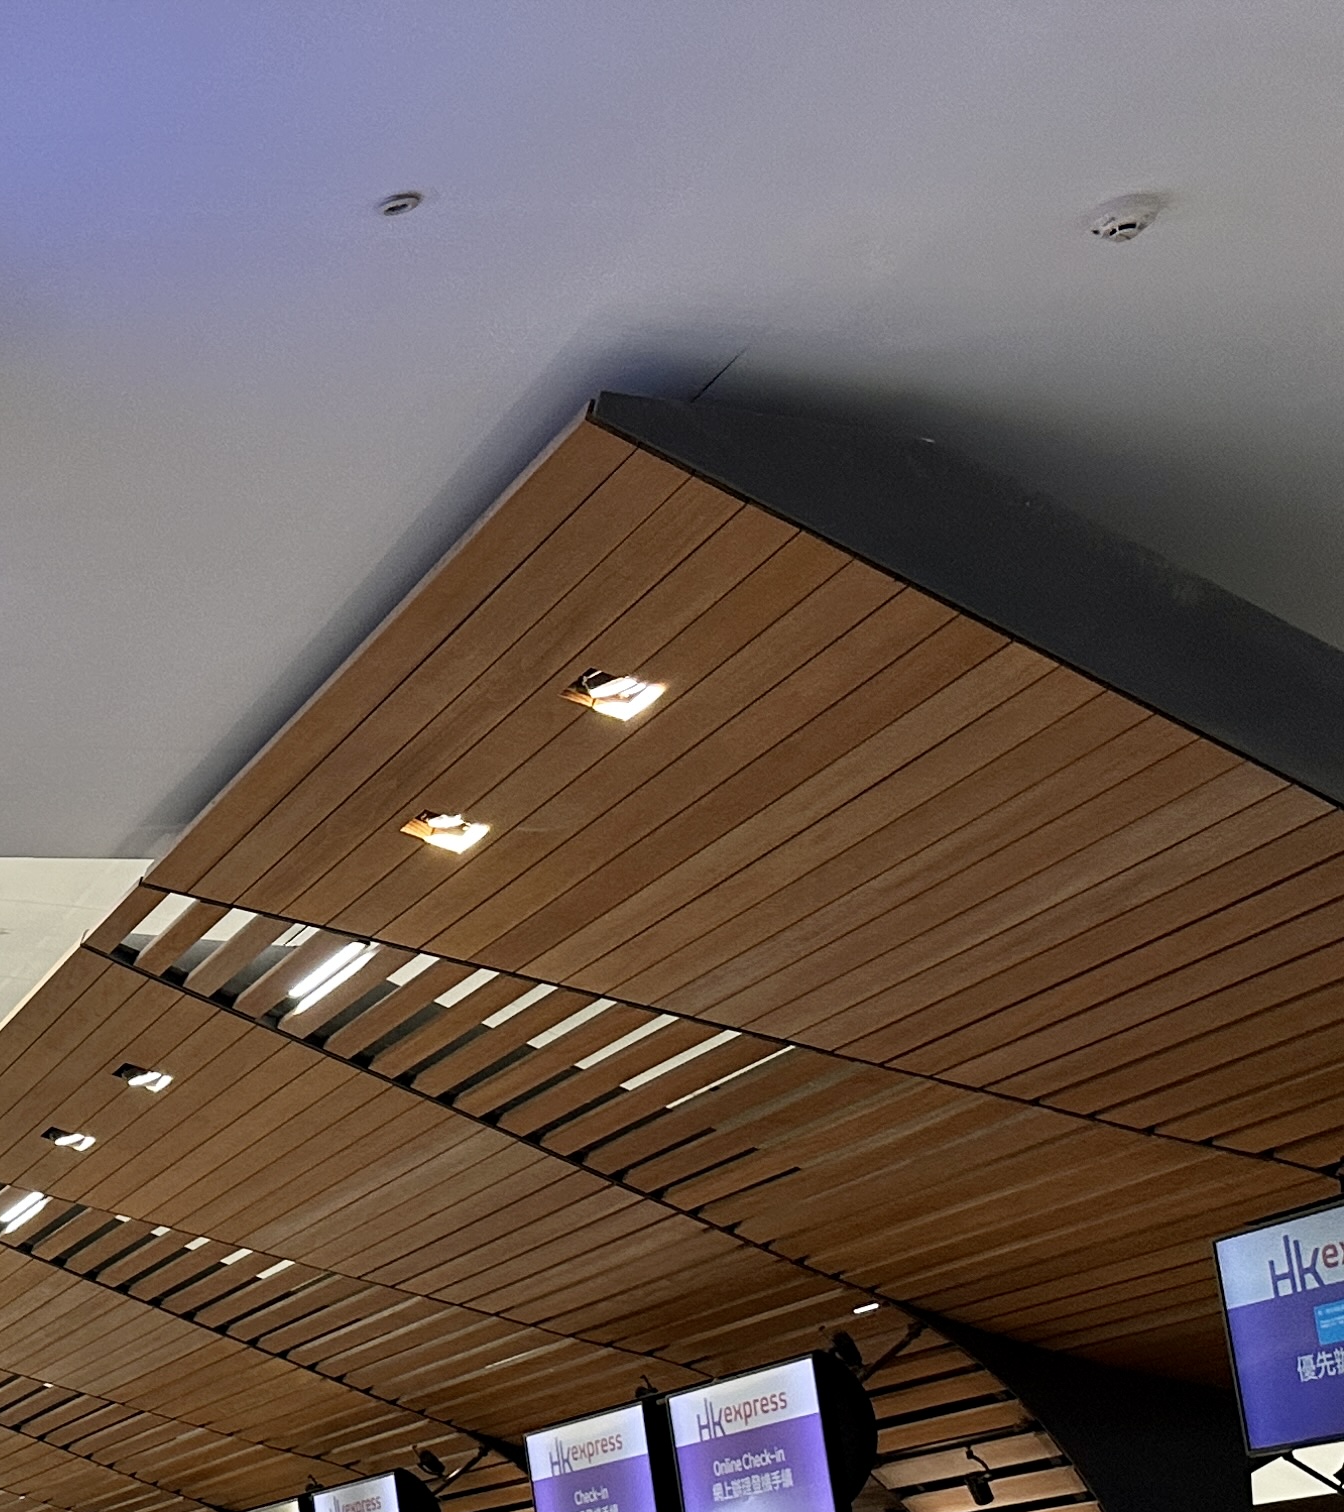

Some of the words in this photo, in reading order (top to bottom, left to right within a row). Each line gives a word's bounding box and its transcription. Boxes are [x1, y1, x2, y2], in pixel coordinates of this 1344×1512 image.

[713, 1456, 743, 1476] Online
[743, 1447, 786, 1470] Check-in
[574, 1486, 609, 1505] Check-in
